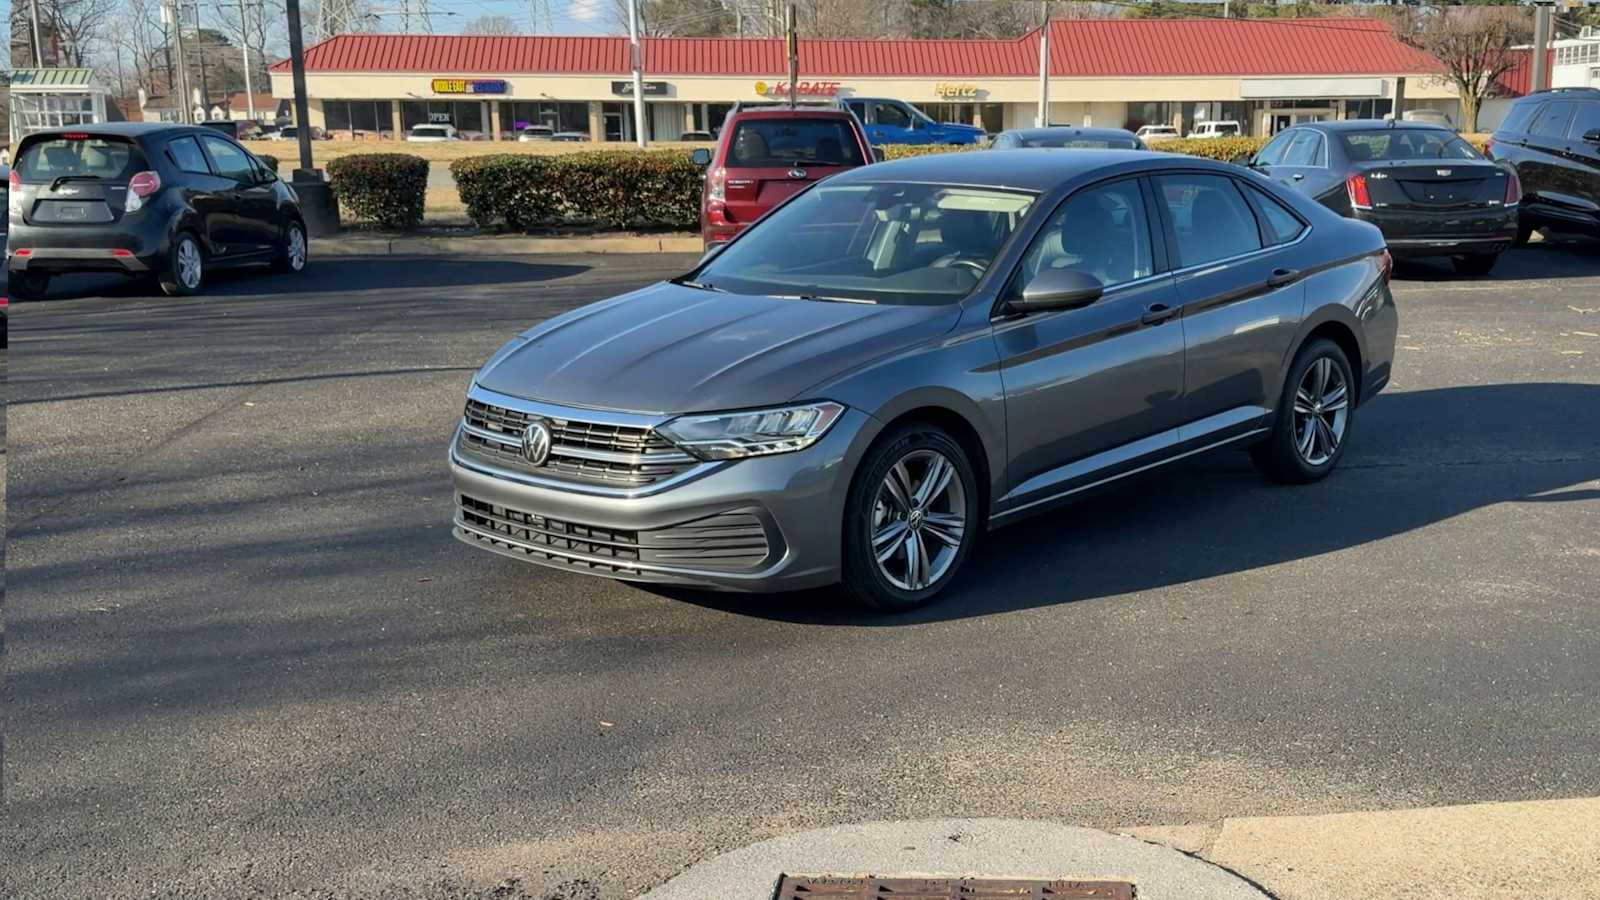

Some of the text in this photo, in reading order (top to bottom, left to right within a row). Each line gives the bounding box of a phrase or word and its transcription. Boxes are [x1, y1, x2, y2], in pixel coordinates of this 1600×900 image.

[774, 81, 840, 96] KRATE
[935, 82, 977, 97] Hertz
[429, 112, 450, 122] OPEN
